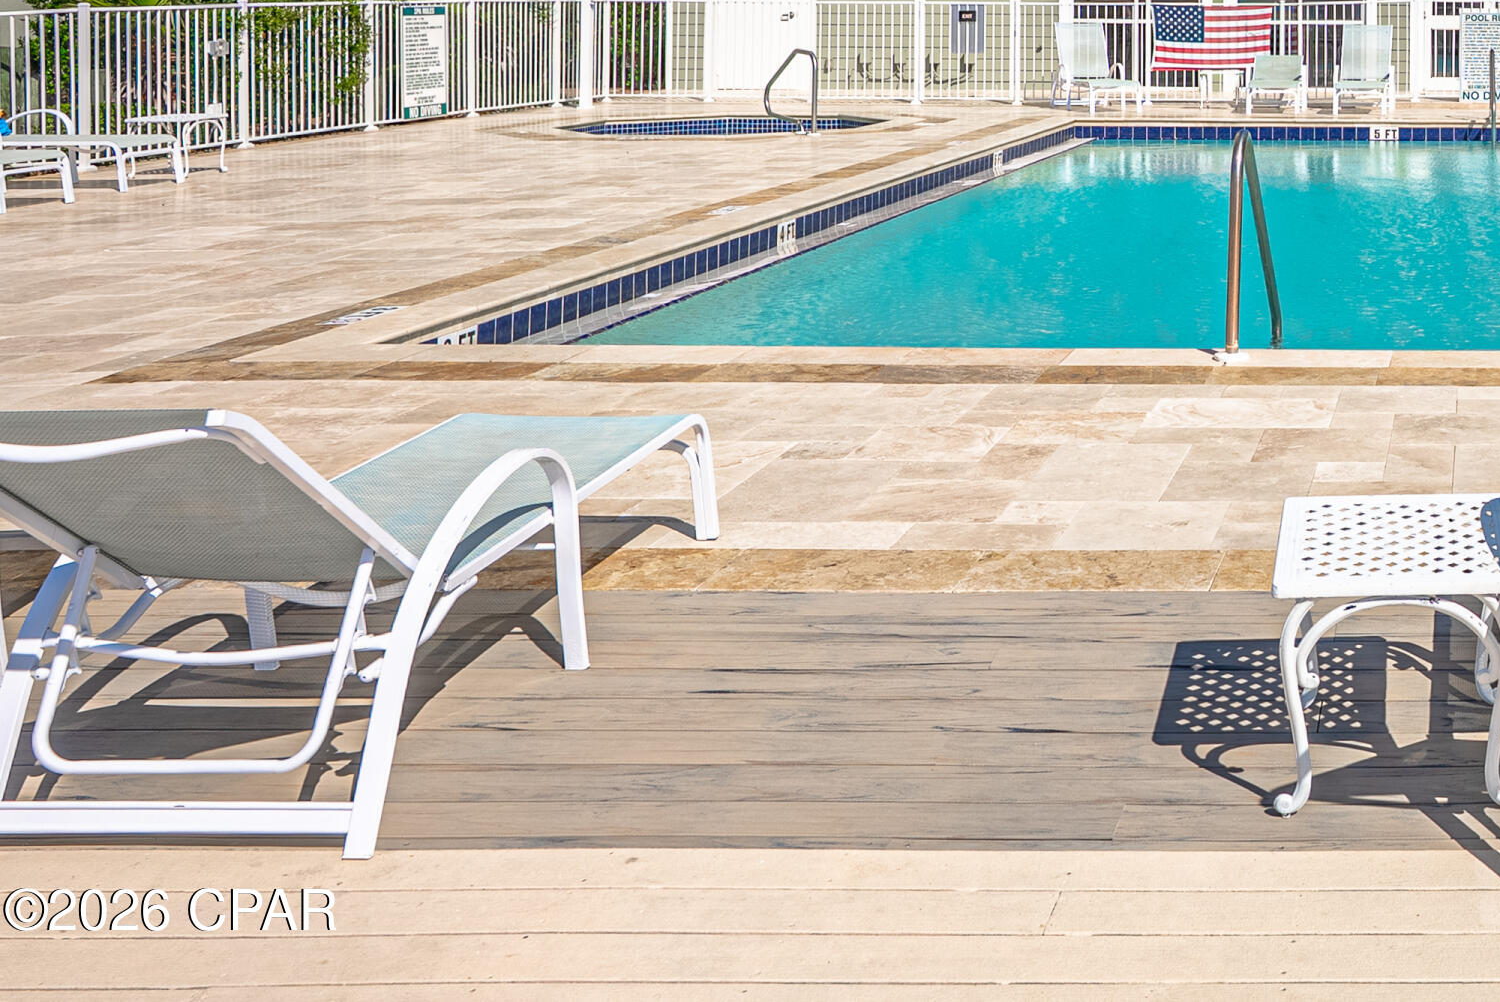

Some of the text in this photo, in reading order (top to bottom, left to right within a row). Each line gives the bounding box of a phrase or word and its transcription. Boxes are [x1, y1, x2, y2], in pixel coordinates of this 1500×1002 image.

[1465, 14, 1490, 22] POOL
[1462, 91, 1480, 100] NO
[409, 104, 442, 119] NO DIVING
[1374, 129, 1397, 139] 5 FT
[780, 224, 785, 243] 4
